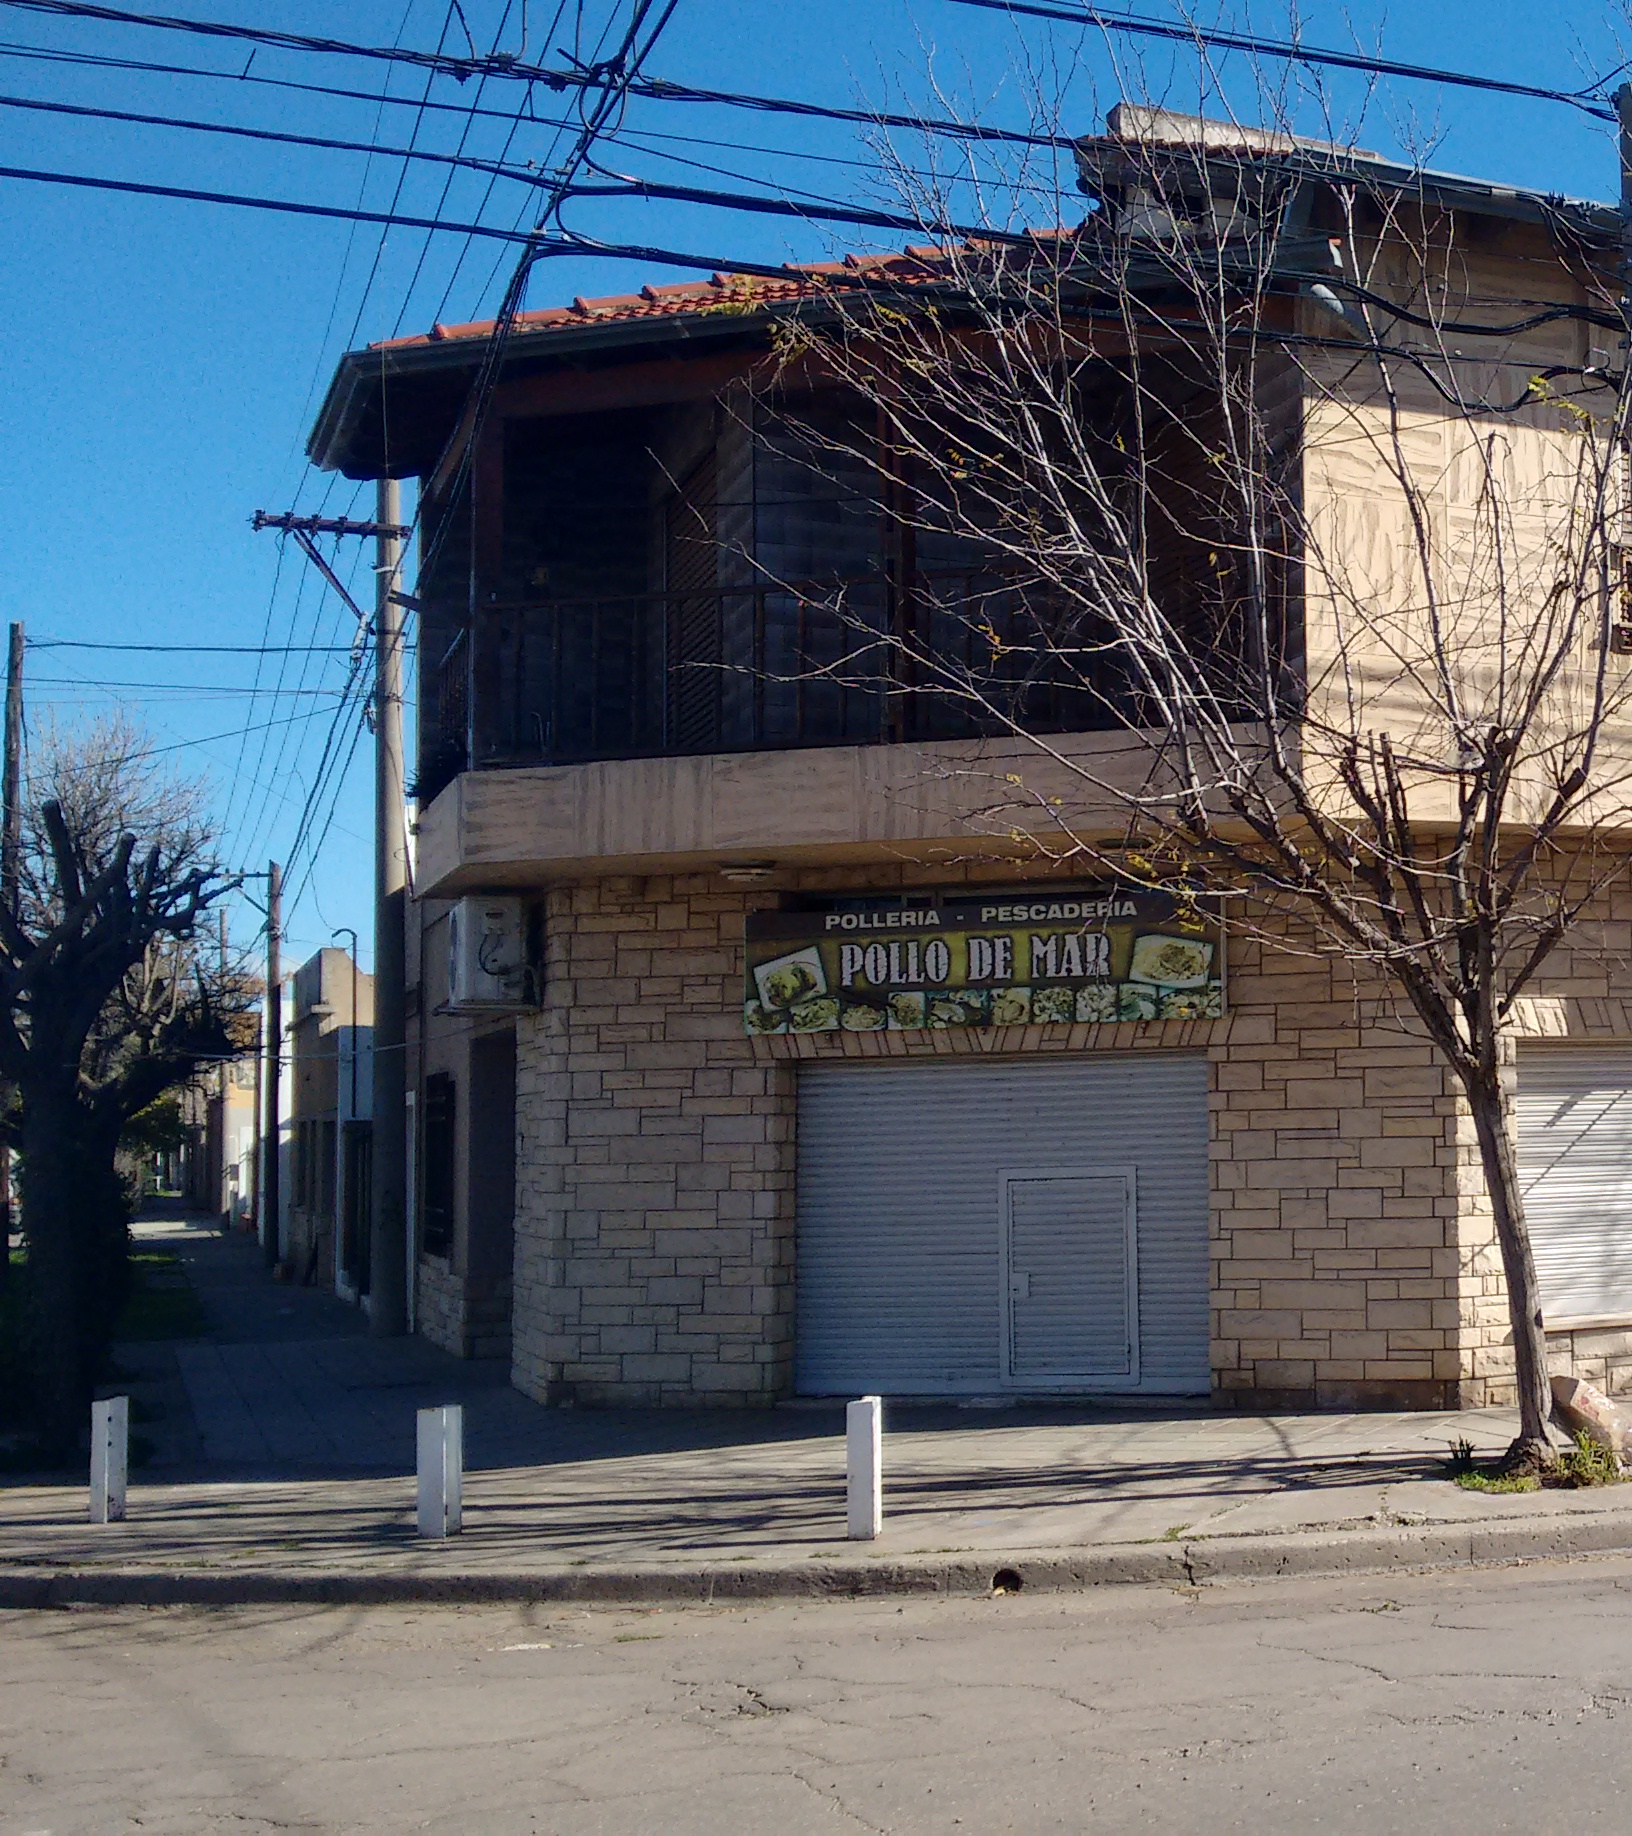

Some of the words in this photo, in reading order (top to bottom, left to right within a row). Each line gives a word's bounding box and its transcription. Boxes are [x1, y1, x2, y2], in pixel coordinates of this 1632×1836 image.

[825, 910, 940, 930] POLLERIA
[981, 900, 1138, 923] PESCADERIA
[840, 939, 949, 987] POLLO
[967, 937, 1012, 981] DE
[1030, 932, 1111, 979] MAR
